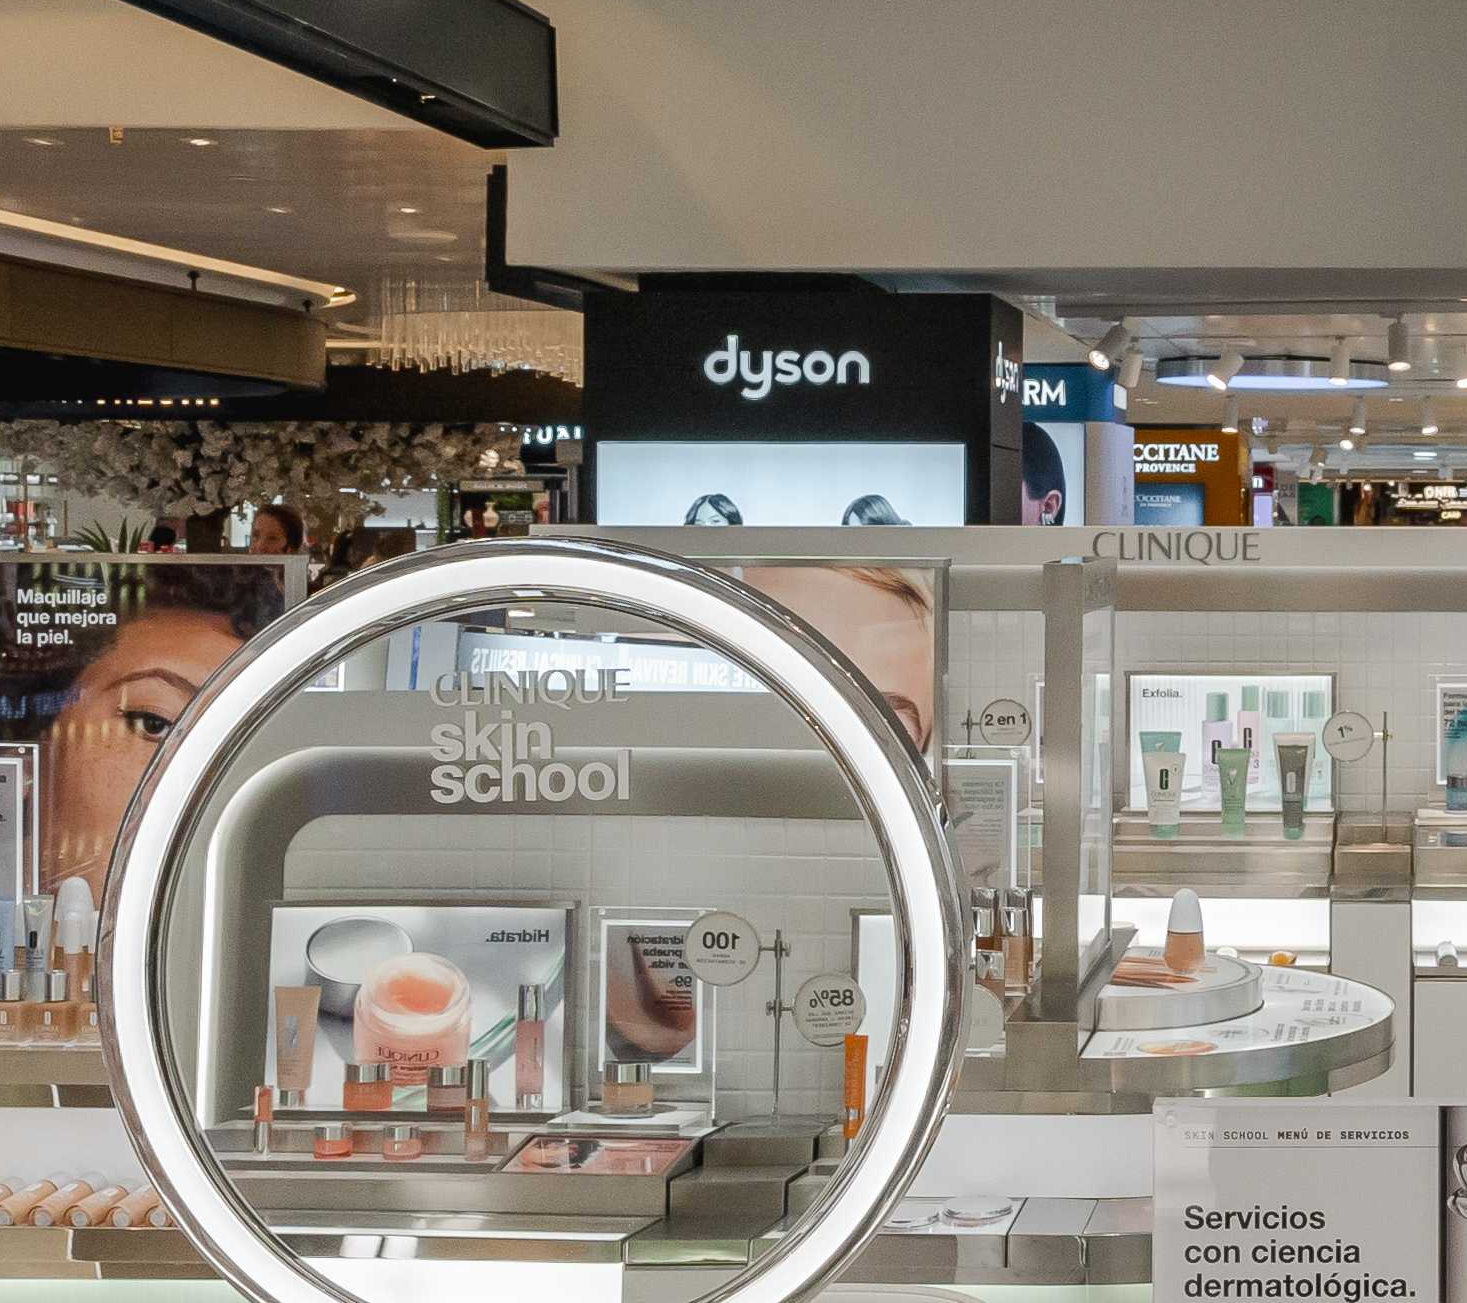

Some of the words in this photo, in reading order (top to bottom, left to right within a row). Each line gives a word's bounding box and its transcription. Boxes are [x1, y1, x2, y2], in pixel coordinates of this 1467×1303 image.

[703, 335, 871, 400] dyson
[1136, 463, 1196, 473] PROVENCE
[1092, 531, 1261, 566] CLINIQUE
[17, 589, 107, 608] Maquillaje
[17, 612, 50, 627] que
[55, 610, 117, 627] mejora
[17, 630, 32, 644] la
[37, 629, 74, 647] piel.
[429, 667, 632, 711] CLINIQUE
[1142, 688, 1183, 699] Exfolia.
[985, 714, 994, 726] 2
[997, 714, 1015, 725] en
[1020, 713, 1027, 724] 1
[430, 710, 553, 760] skin
[430, 750, 631, 804] school
[1223, 1131, 1269, 1140] SCHOOL
[1278, 1128, 1308, 1140] MENÚ
[1317, 1130, 1331, 1140] DE
[1340, 1130, 1409, 1140] SERVICIOS
[1183, 1204, 1326, 1231] Servicios
[1184, 1243, 1240, 1264] con
[1250, 1240, 1360, 1265] ciencia
[1183, 1273, 1416, 1303] dermatológica.
